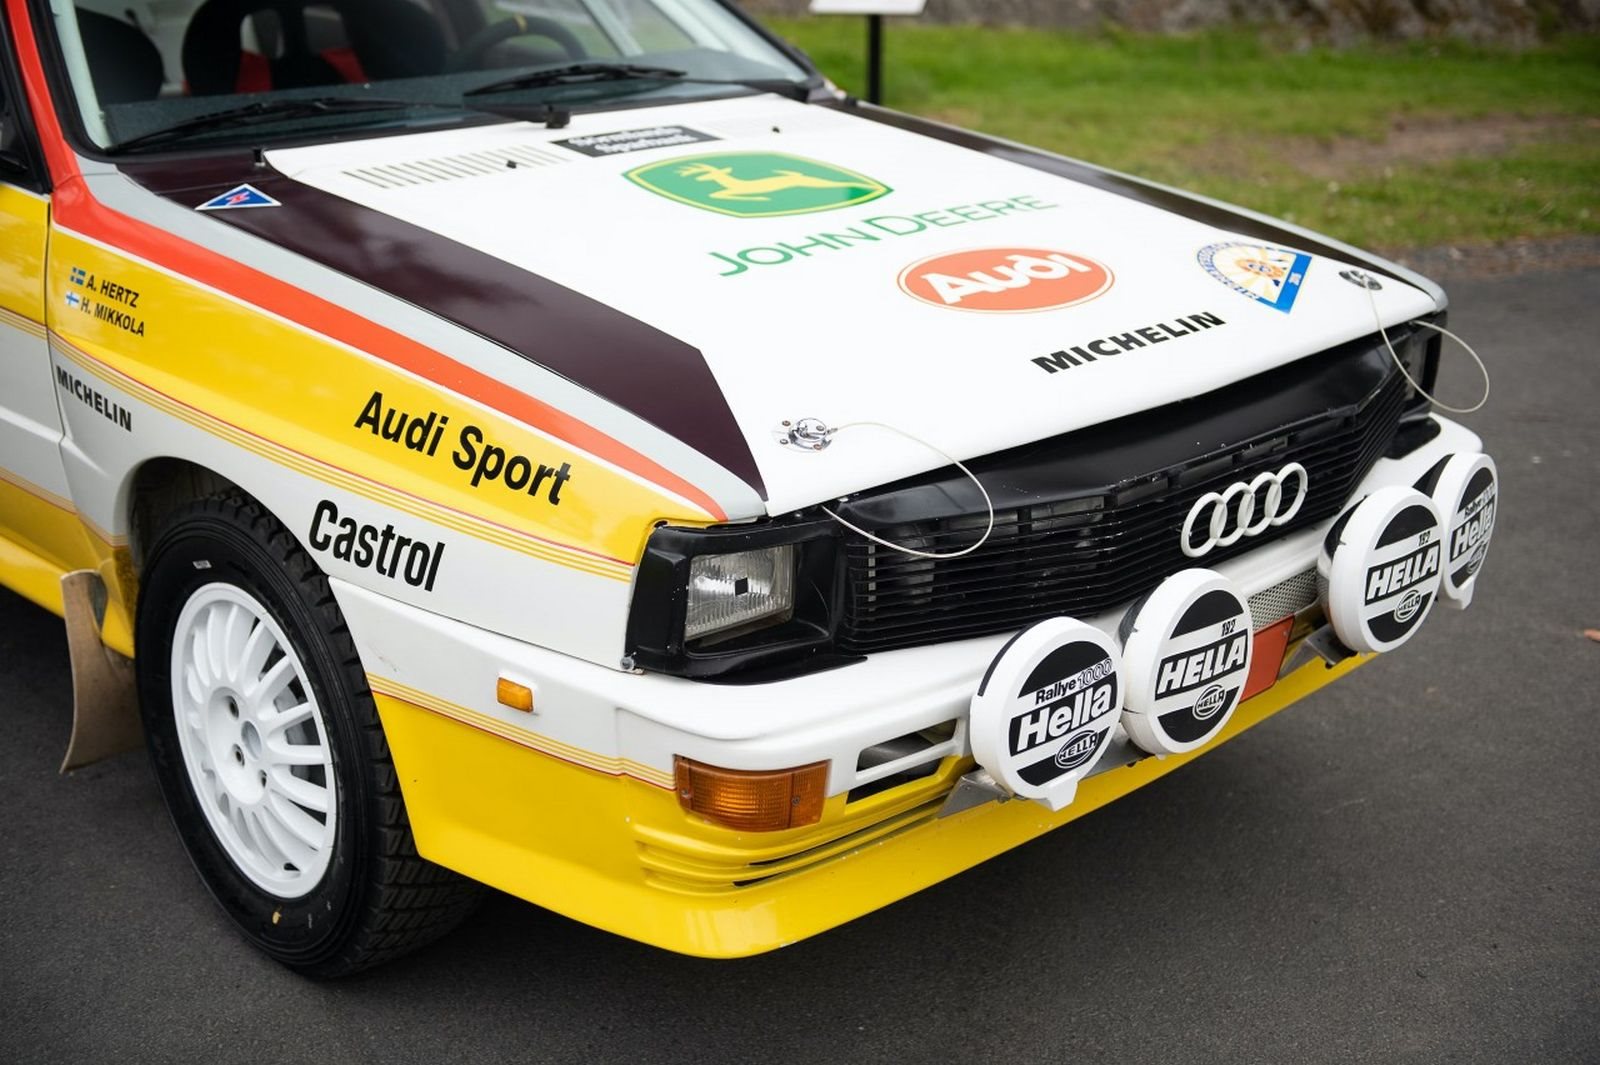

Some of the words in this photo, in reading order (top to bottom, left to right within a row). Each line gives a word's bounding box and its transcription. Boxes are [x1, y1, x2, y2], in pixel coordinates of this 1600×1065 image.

[708, 225, 881, 277] JOHN
[861, 195, 1059, 236] DEERE
[85, 275, 97, 291] A.
[100, 279, 140, 308] HERTZ
[921, 253, 1092, 305] Audi
[80, 297, 91, 314] H.
[94, 301, 145, 337] MIKKOLA
[1030, 311, 1226, 374] MICHELIN
[56, 365, 132, 432] MICHELIN
[353, 391, 449, 457] Audi
[452, 425, 571, 506] Sport
[308, 499, 446, 592] Castrol
[1366, 544, 1440, 601] HELLA
[1221, 618, 1237, 637] 192
[1035, 679, 1077, 705] Rallye
[1077, 658, 1113, 689] 1000
[1156, 637, 1246, 695] HELLA
[1016, 682, 1112, 752] Hella
[1197, 692, 1225, 708] HELLA
[1059, 731, 1099, 759] HELLA
